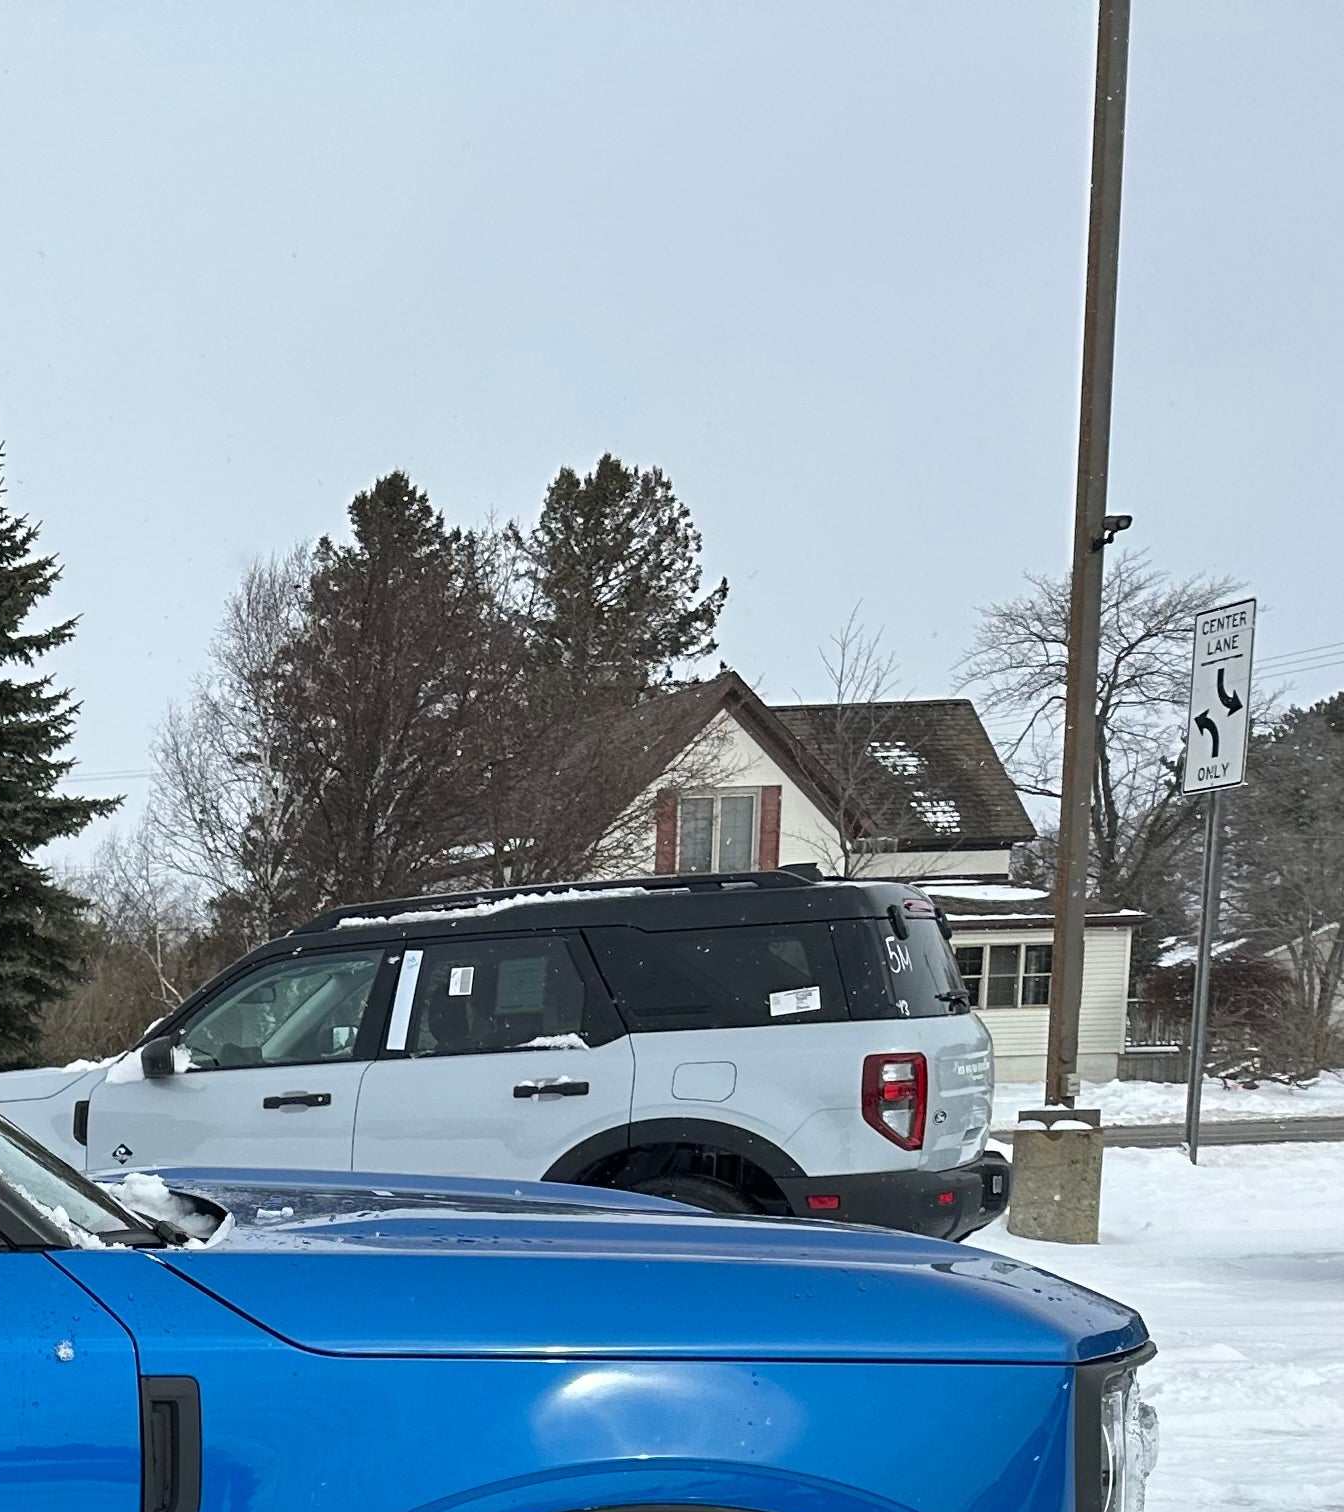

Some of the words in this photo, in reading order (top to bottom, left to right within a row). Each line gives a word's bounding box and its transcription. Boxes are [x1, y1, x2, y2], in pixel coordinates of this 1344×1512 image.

[1201, 610, 1248, 636] CENTER
[1206, 634, 1240, 656] LANE
[1197, 762, 1231, 782] ONLY
